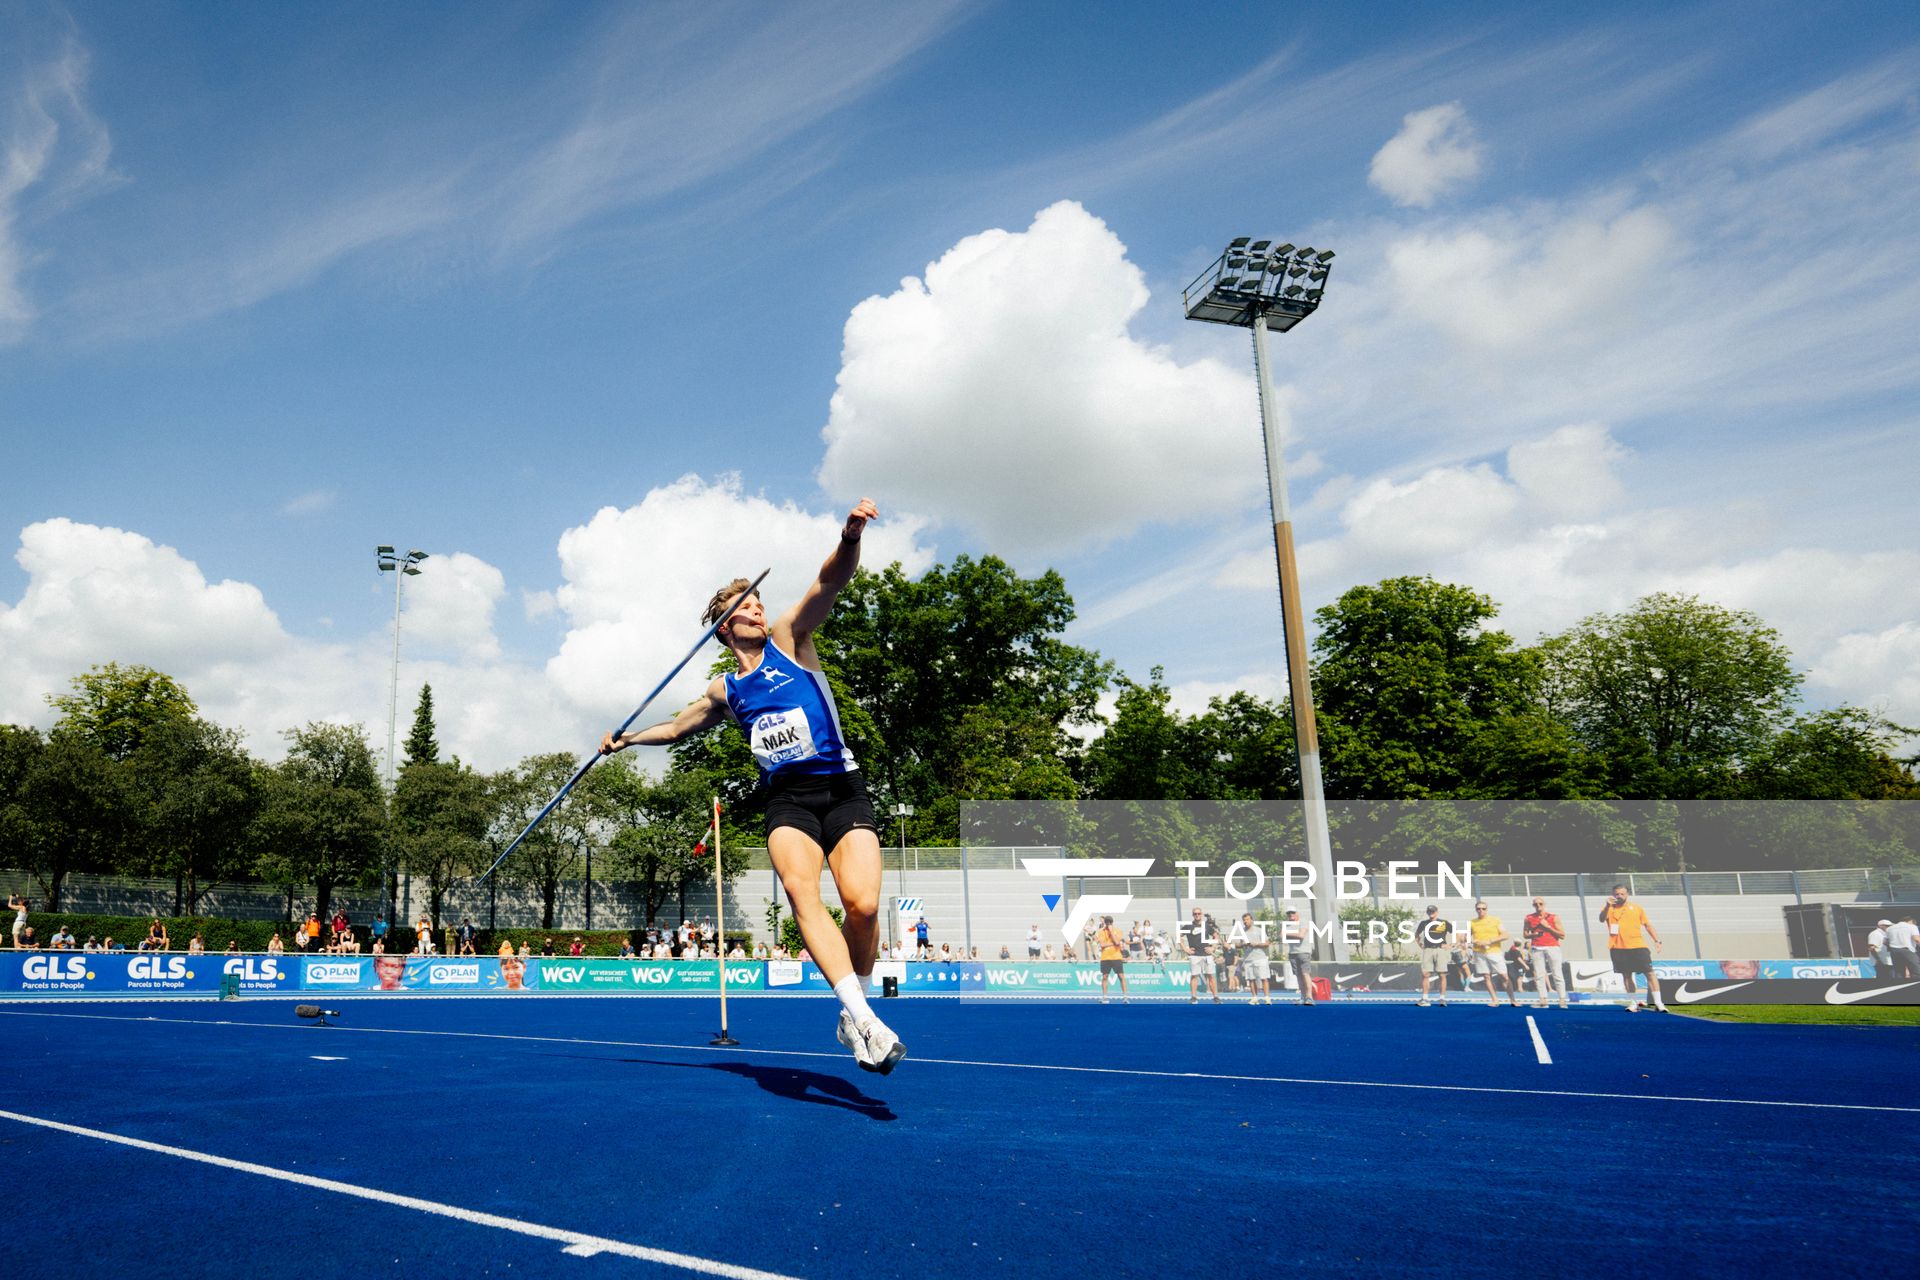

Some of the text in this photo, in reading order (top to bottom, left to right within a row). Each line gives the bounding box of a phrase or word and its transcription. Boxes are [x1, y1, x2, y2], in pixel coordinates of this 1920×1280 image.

[758, 714, 786, 731] GLS
[761, 726, 800, 751] MAK
[329, 968, 358, 976] PLAN
[450, 968, 476, 976] PLAN
[541, 966, 586, 983] WGV
[631, 967, 674, 984] WGV
[986, 969, 1029, 985] WGV
[60, 982, 85, 991] People
[162, 981, 185, 989] People
[255, 982, 277, 990] People
